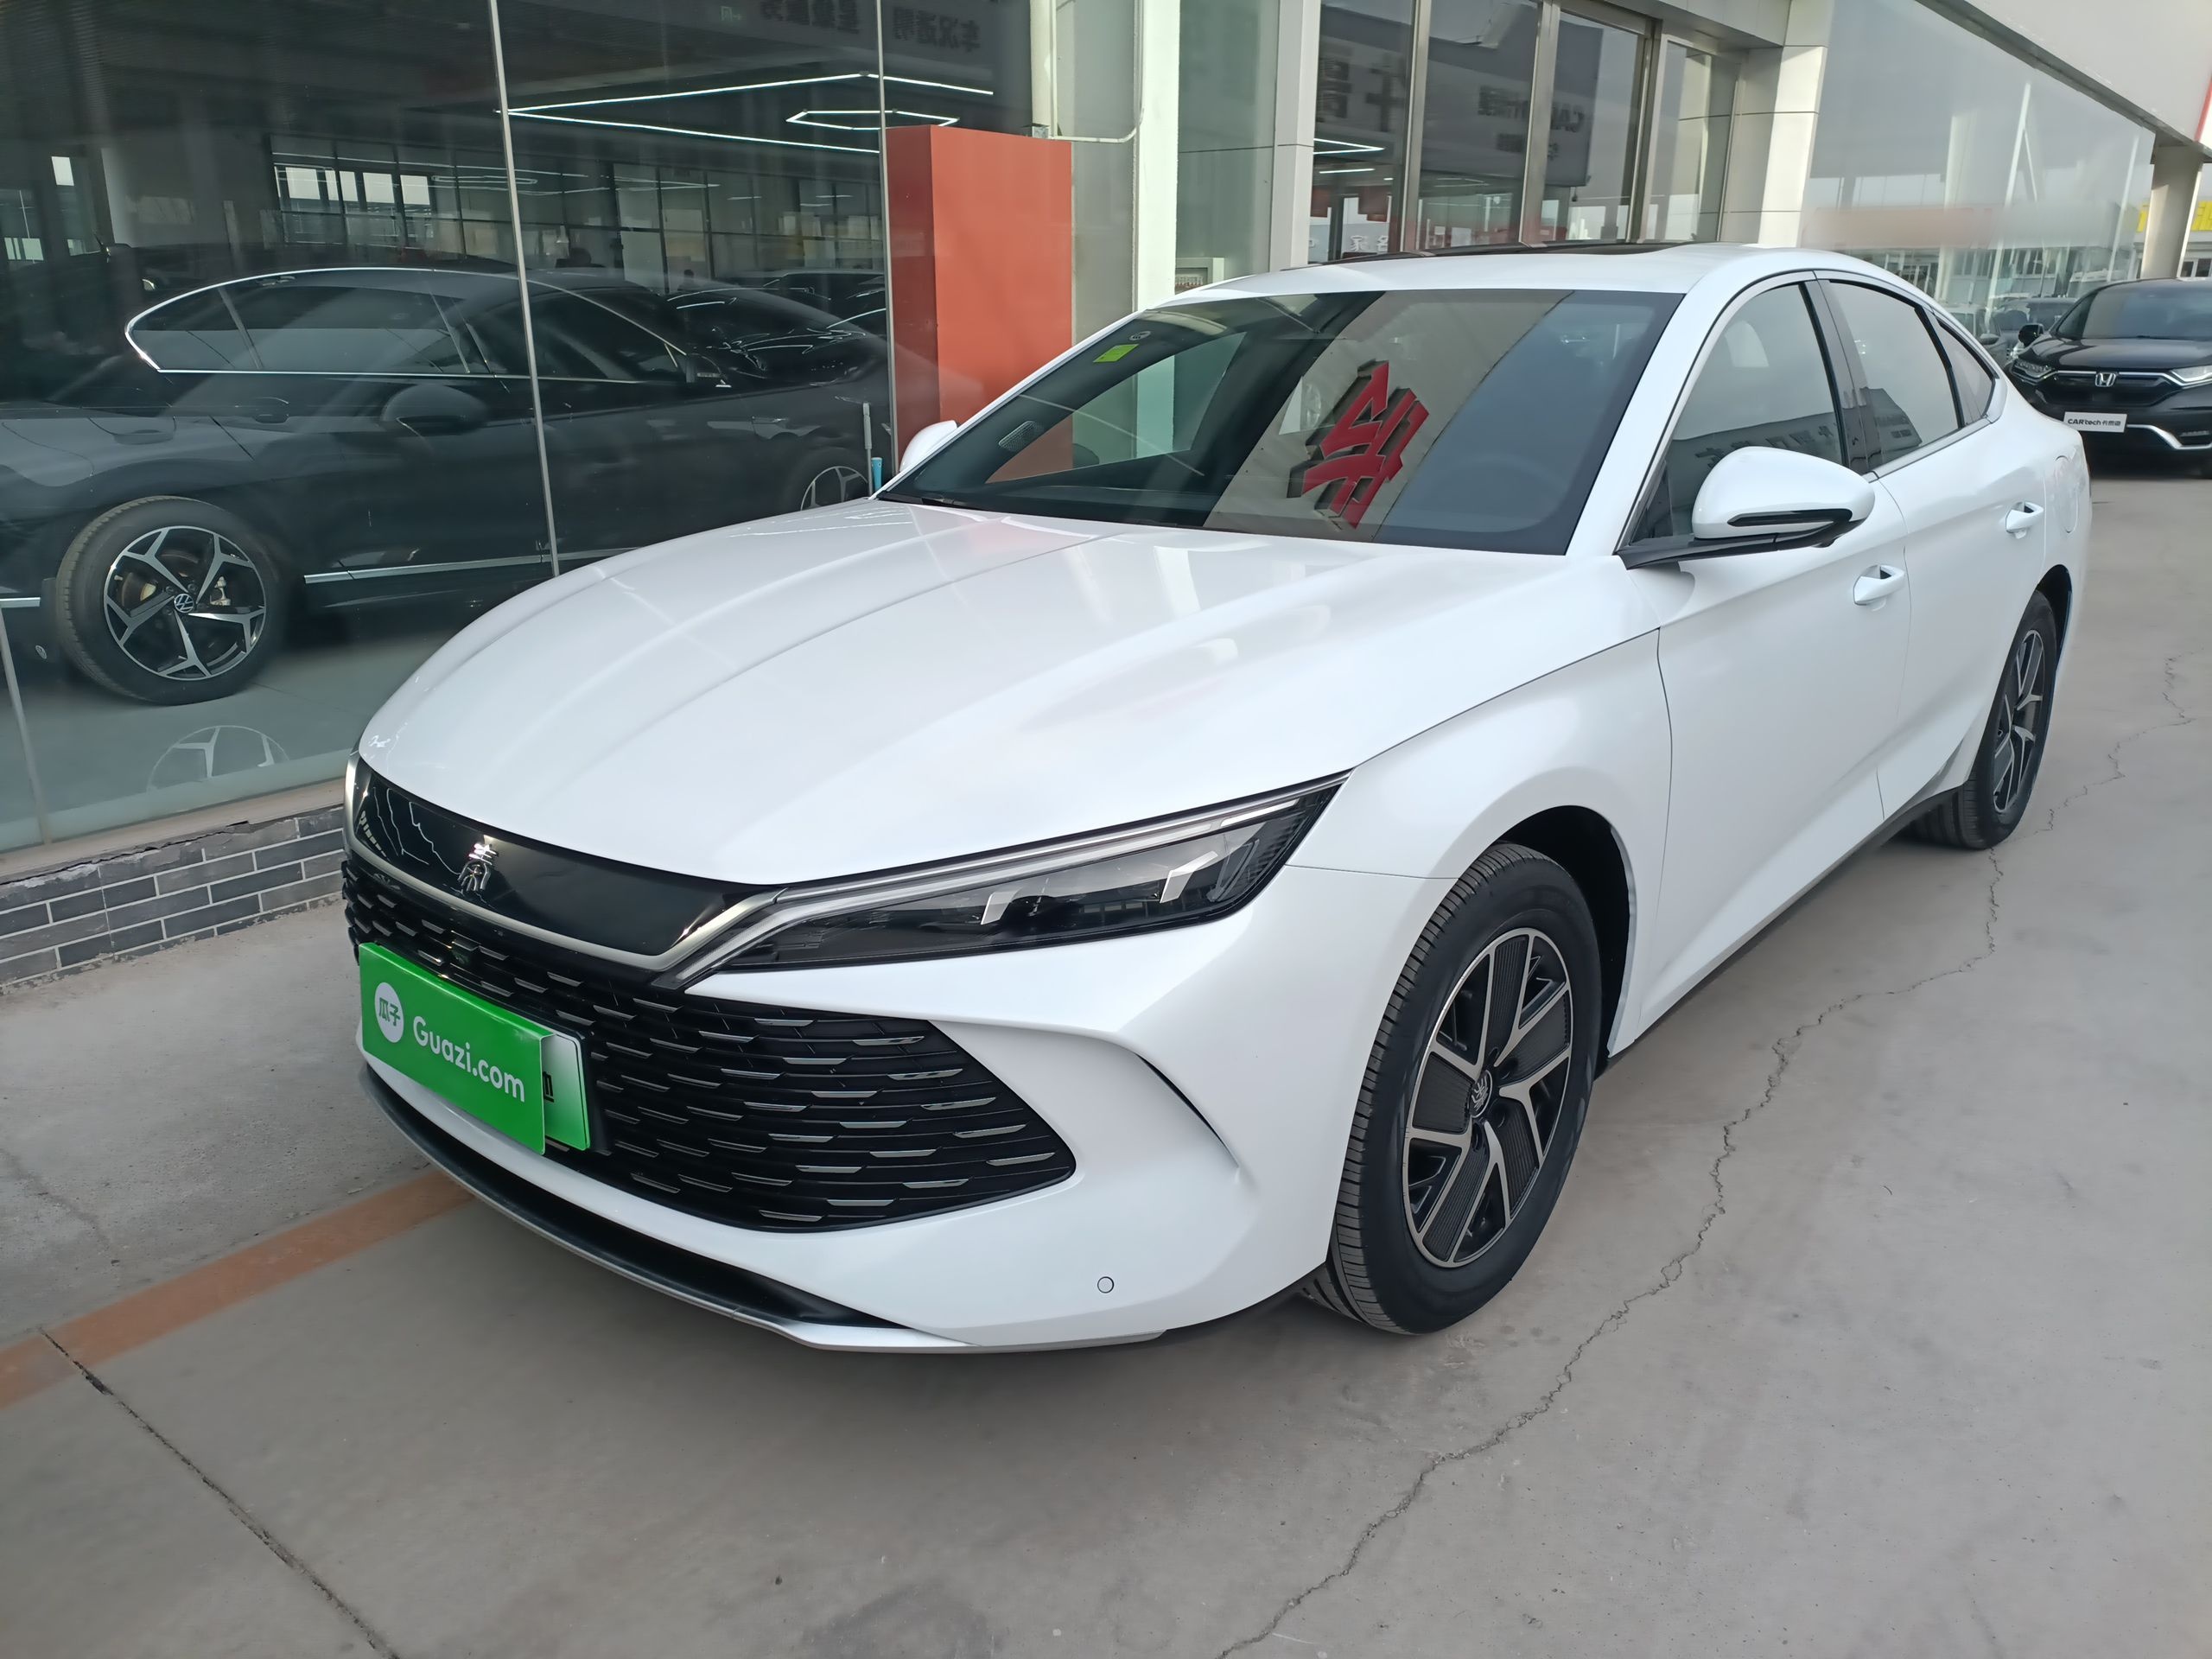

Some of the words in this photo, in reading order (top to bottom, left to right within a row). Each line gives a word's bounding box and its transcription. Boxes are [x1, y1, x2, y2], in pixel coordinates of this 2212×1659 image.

[458, 843, 497, 892] 秦
[378, 996, 401, 1027] 瓜子
[413, 1015, 525, 1103] Guazi.com
